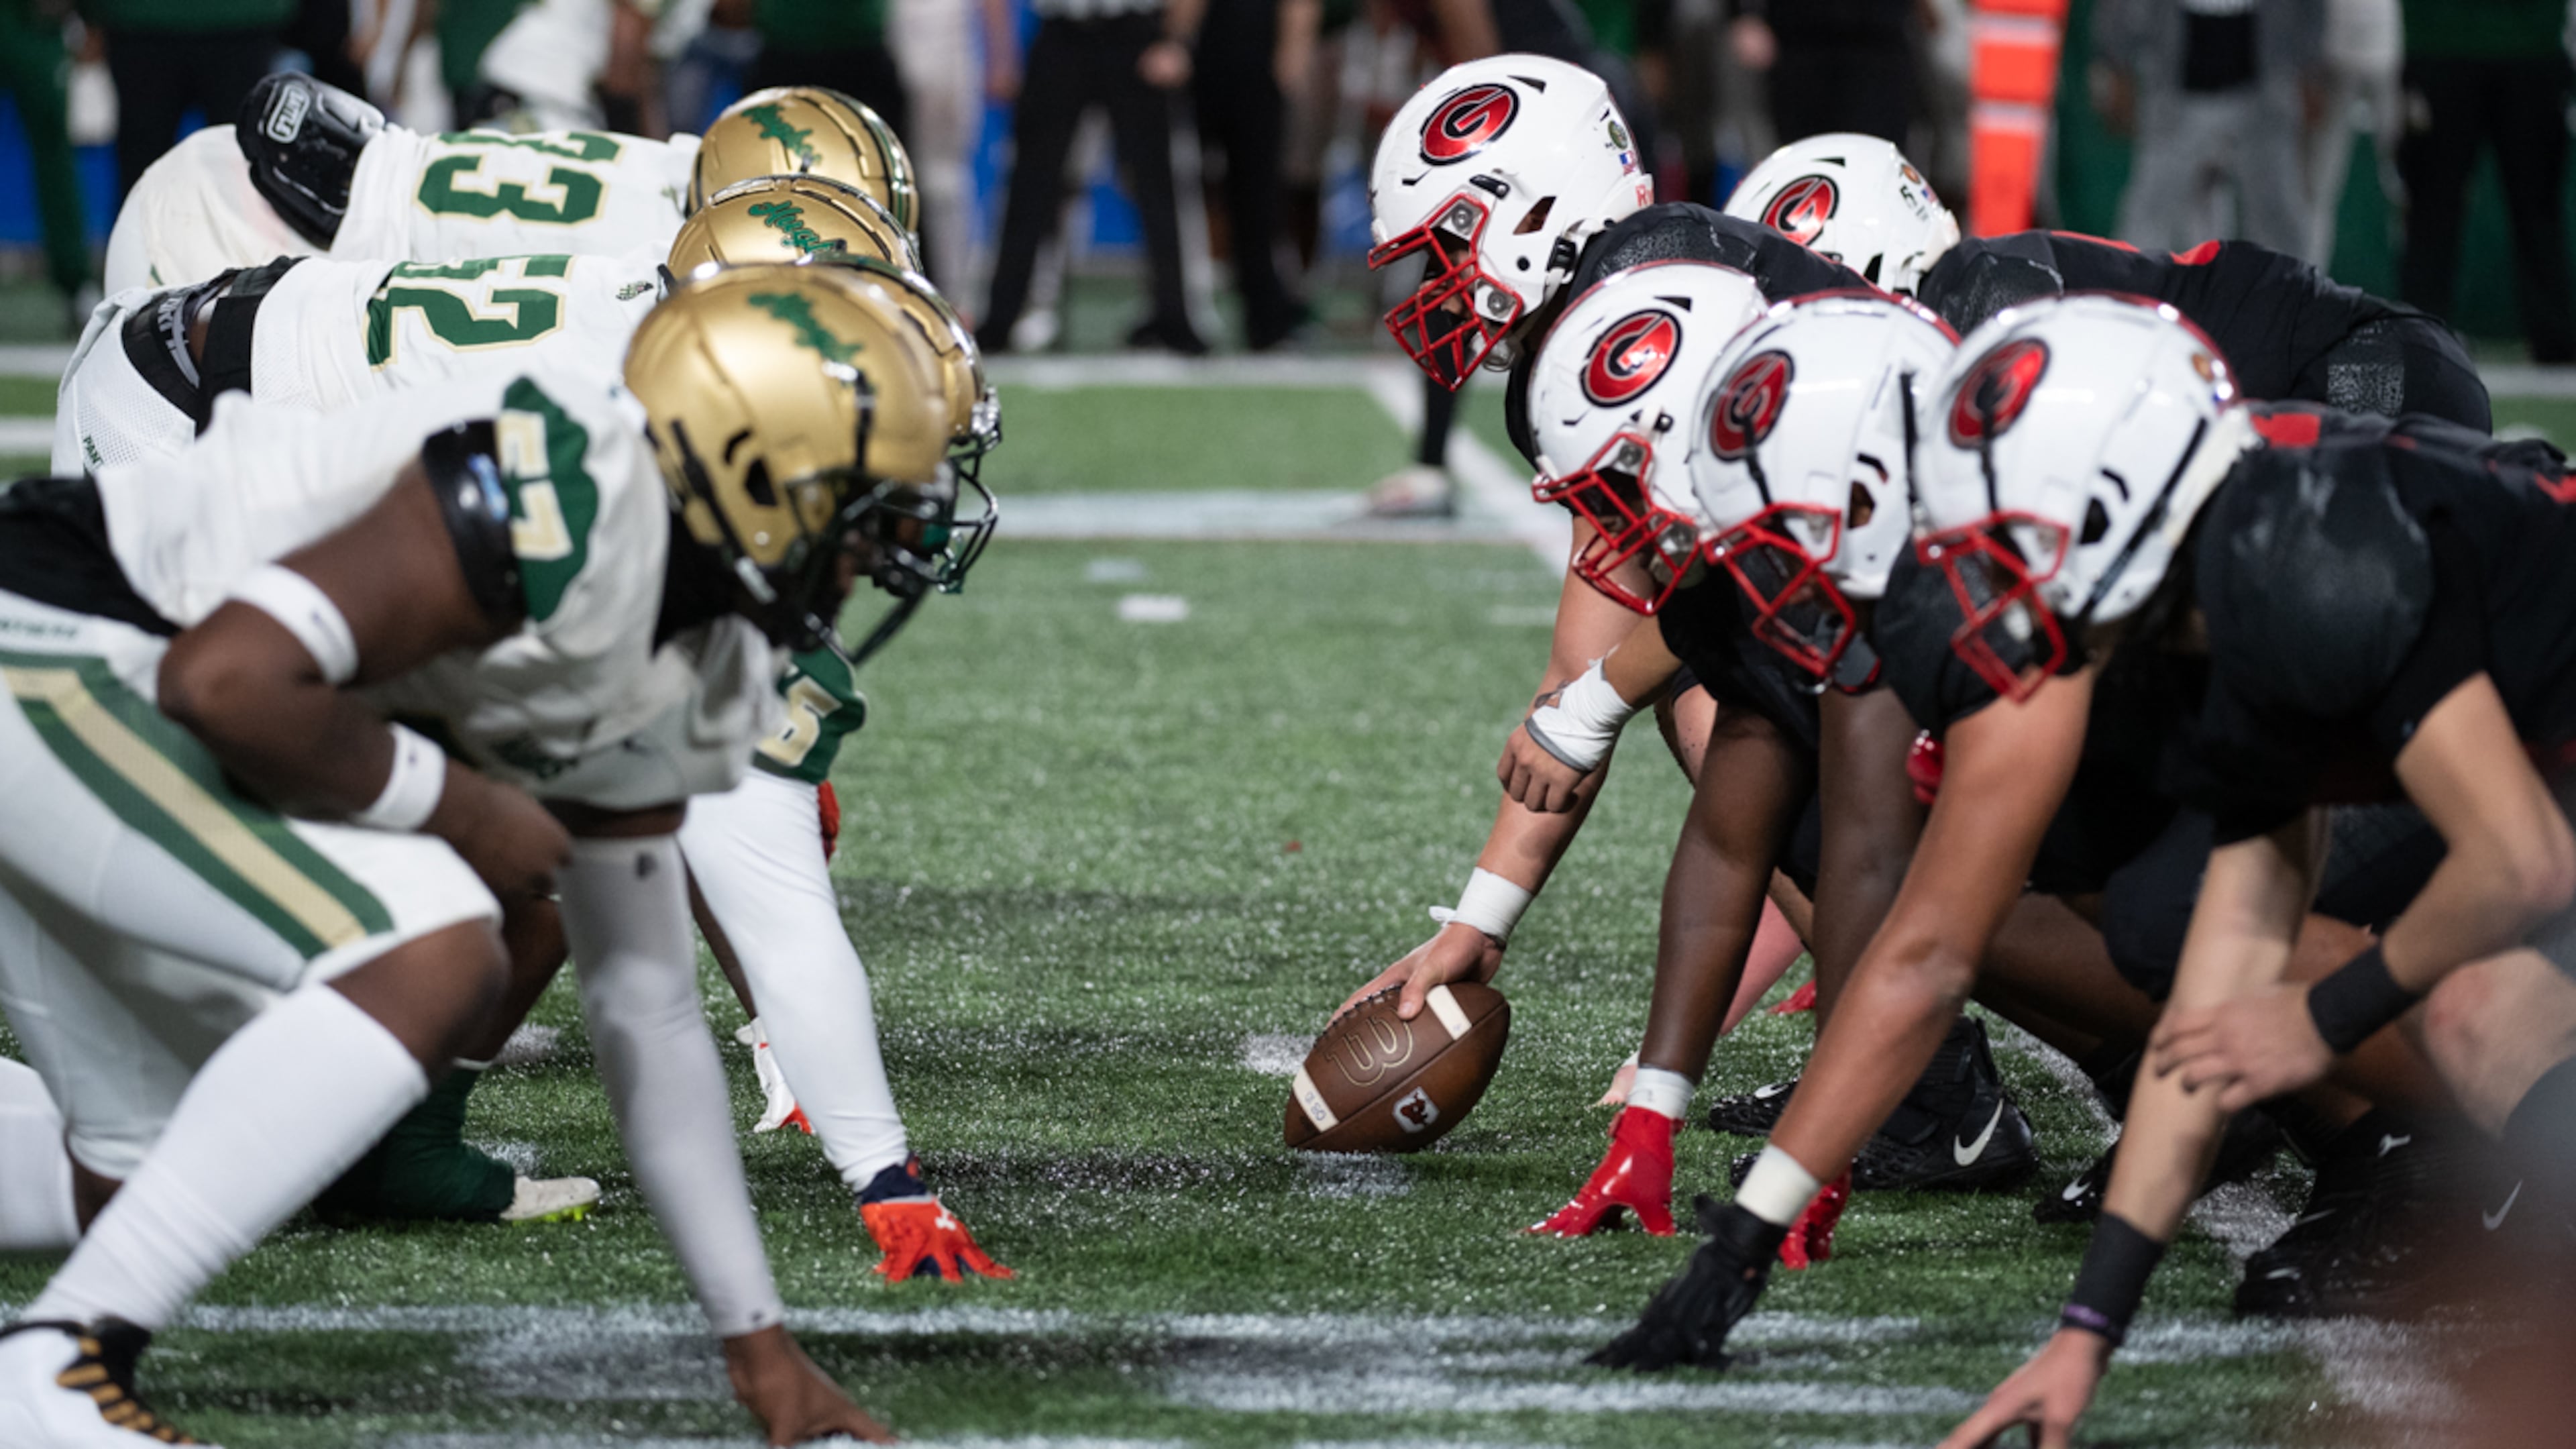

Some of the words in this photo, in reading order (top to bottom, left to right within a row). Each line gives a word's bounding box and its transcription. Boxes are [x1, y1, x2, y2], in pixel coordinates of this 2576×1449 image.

[1421, 85, 1517, 163] G
[1581, 311, 1680, 407] G
[1710, 350, 1794, 460] G
